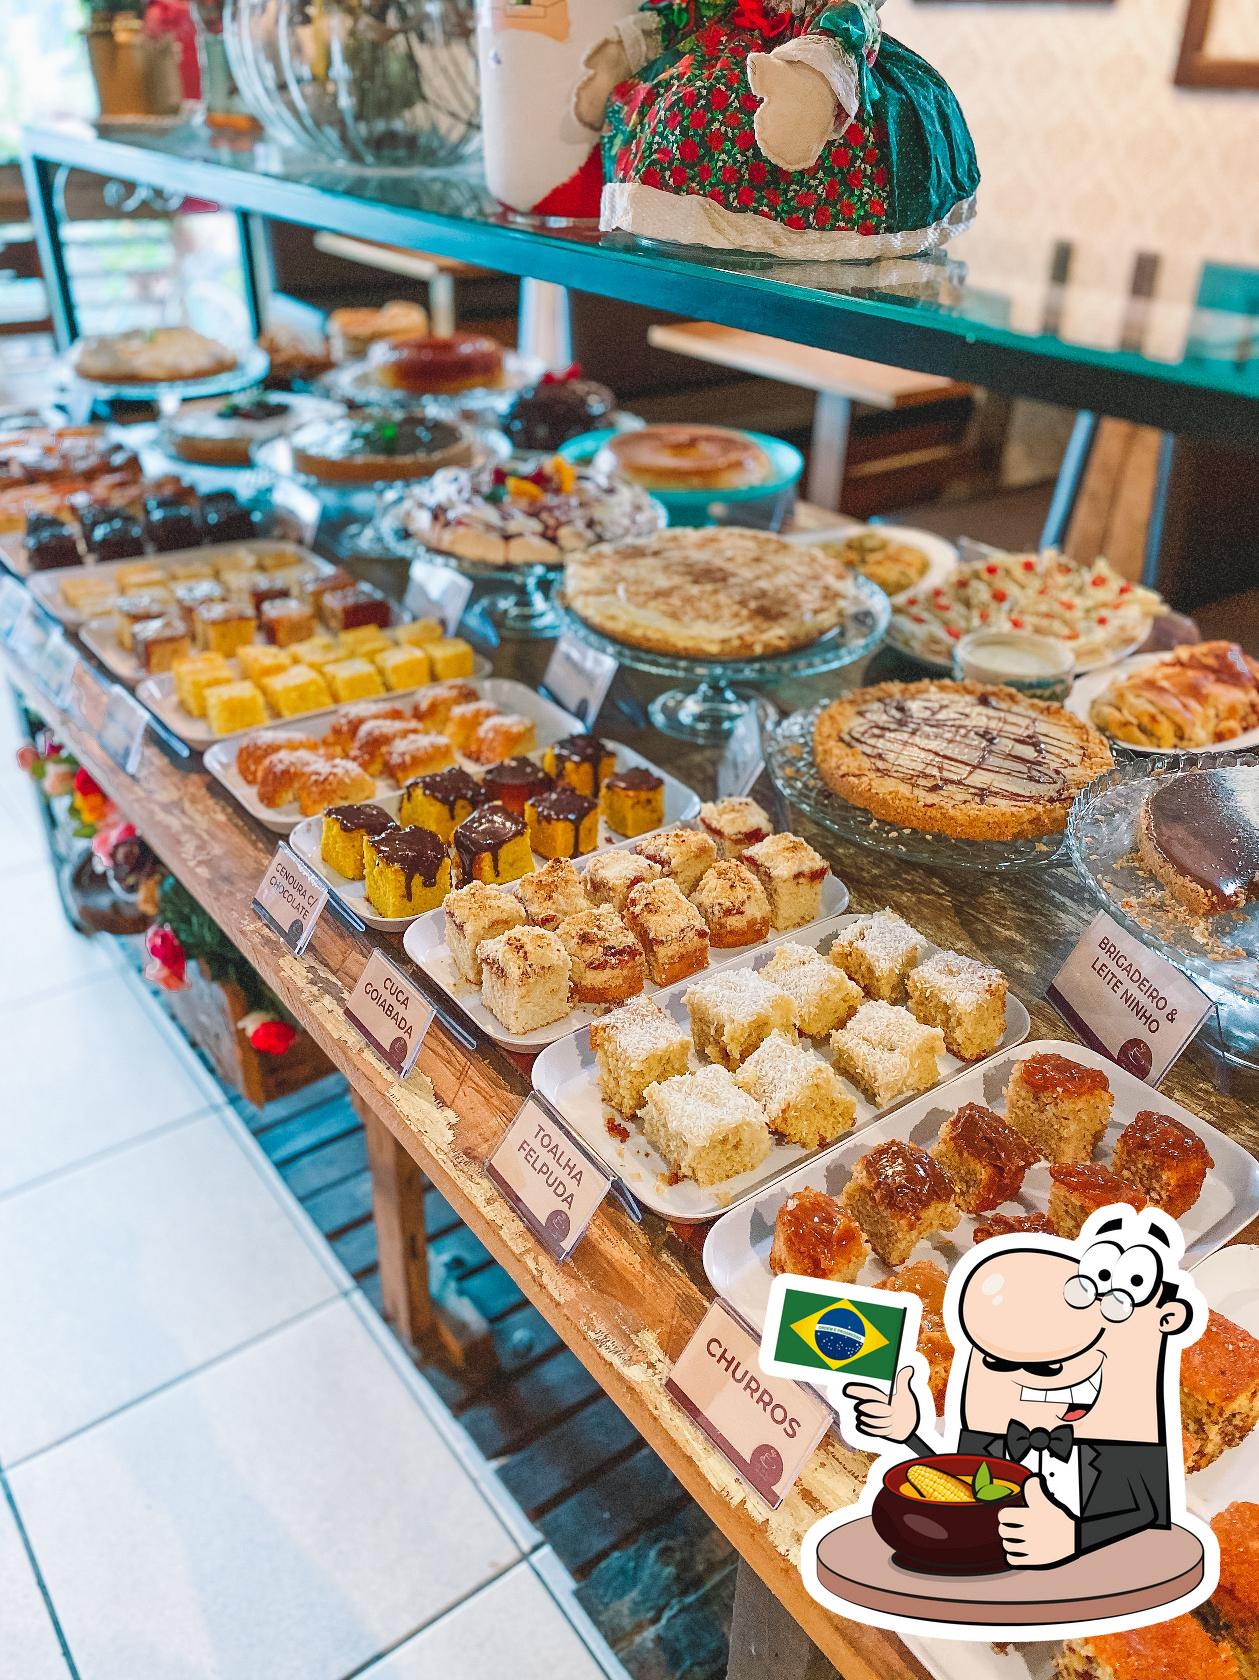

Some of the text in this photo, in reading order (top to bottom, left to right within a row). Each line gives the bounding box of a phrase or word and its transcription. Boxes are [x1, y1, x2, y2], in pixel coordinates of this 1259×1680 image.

[269, 875, 309, 921] CHOCOLATE
[275, 862, 318, 907] CENOURA C/
[363, 982, 413, 1040] GOIABADA
[383, 976, 410, 1010] CUCA
[1090, 956, 1160, 1034] LEITE NINHO
[1097, 936, 1178, 1023] BRIGADEIRO &
[517, 1139, 575, 1211] FELPUDA
[532, 1123, 584, 1188] TOALHA
[706, 1336, 802, 1439] CHURROS
